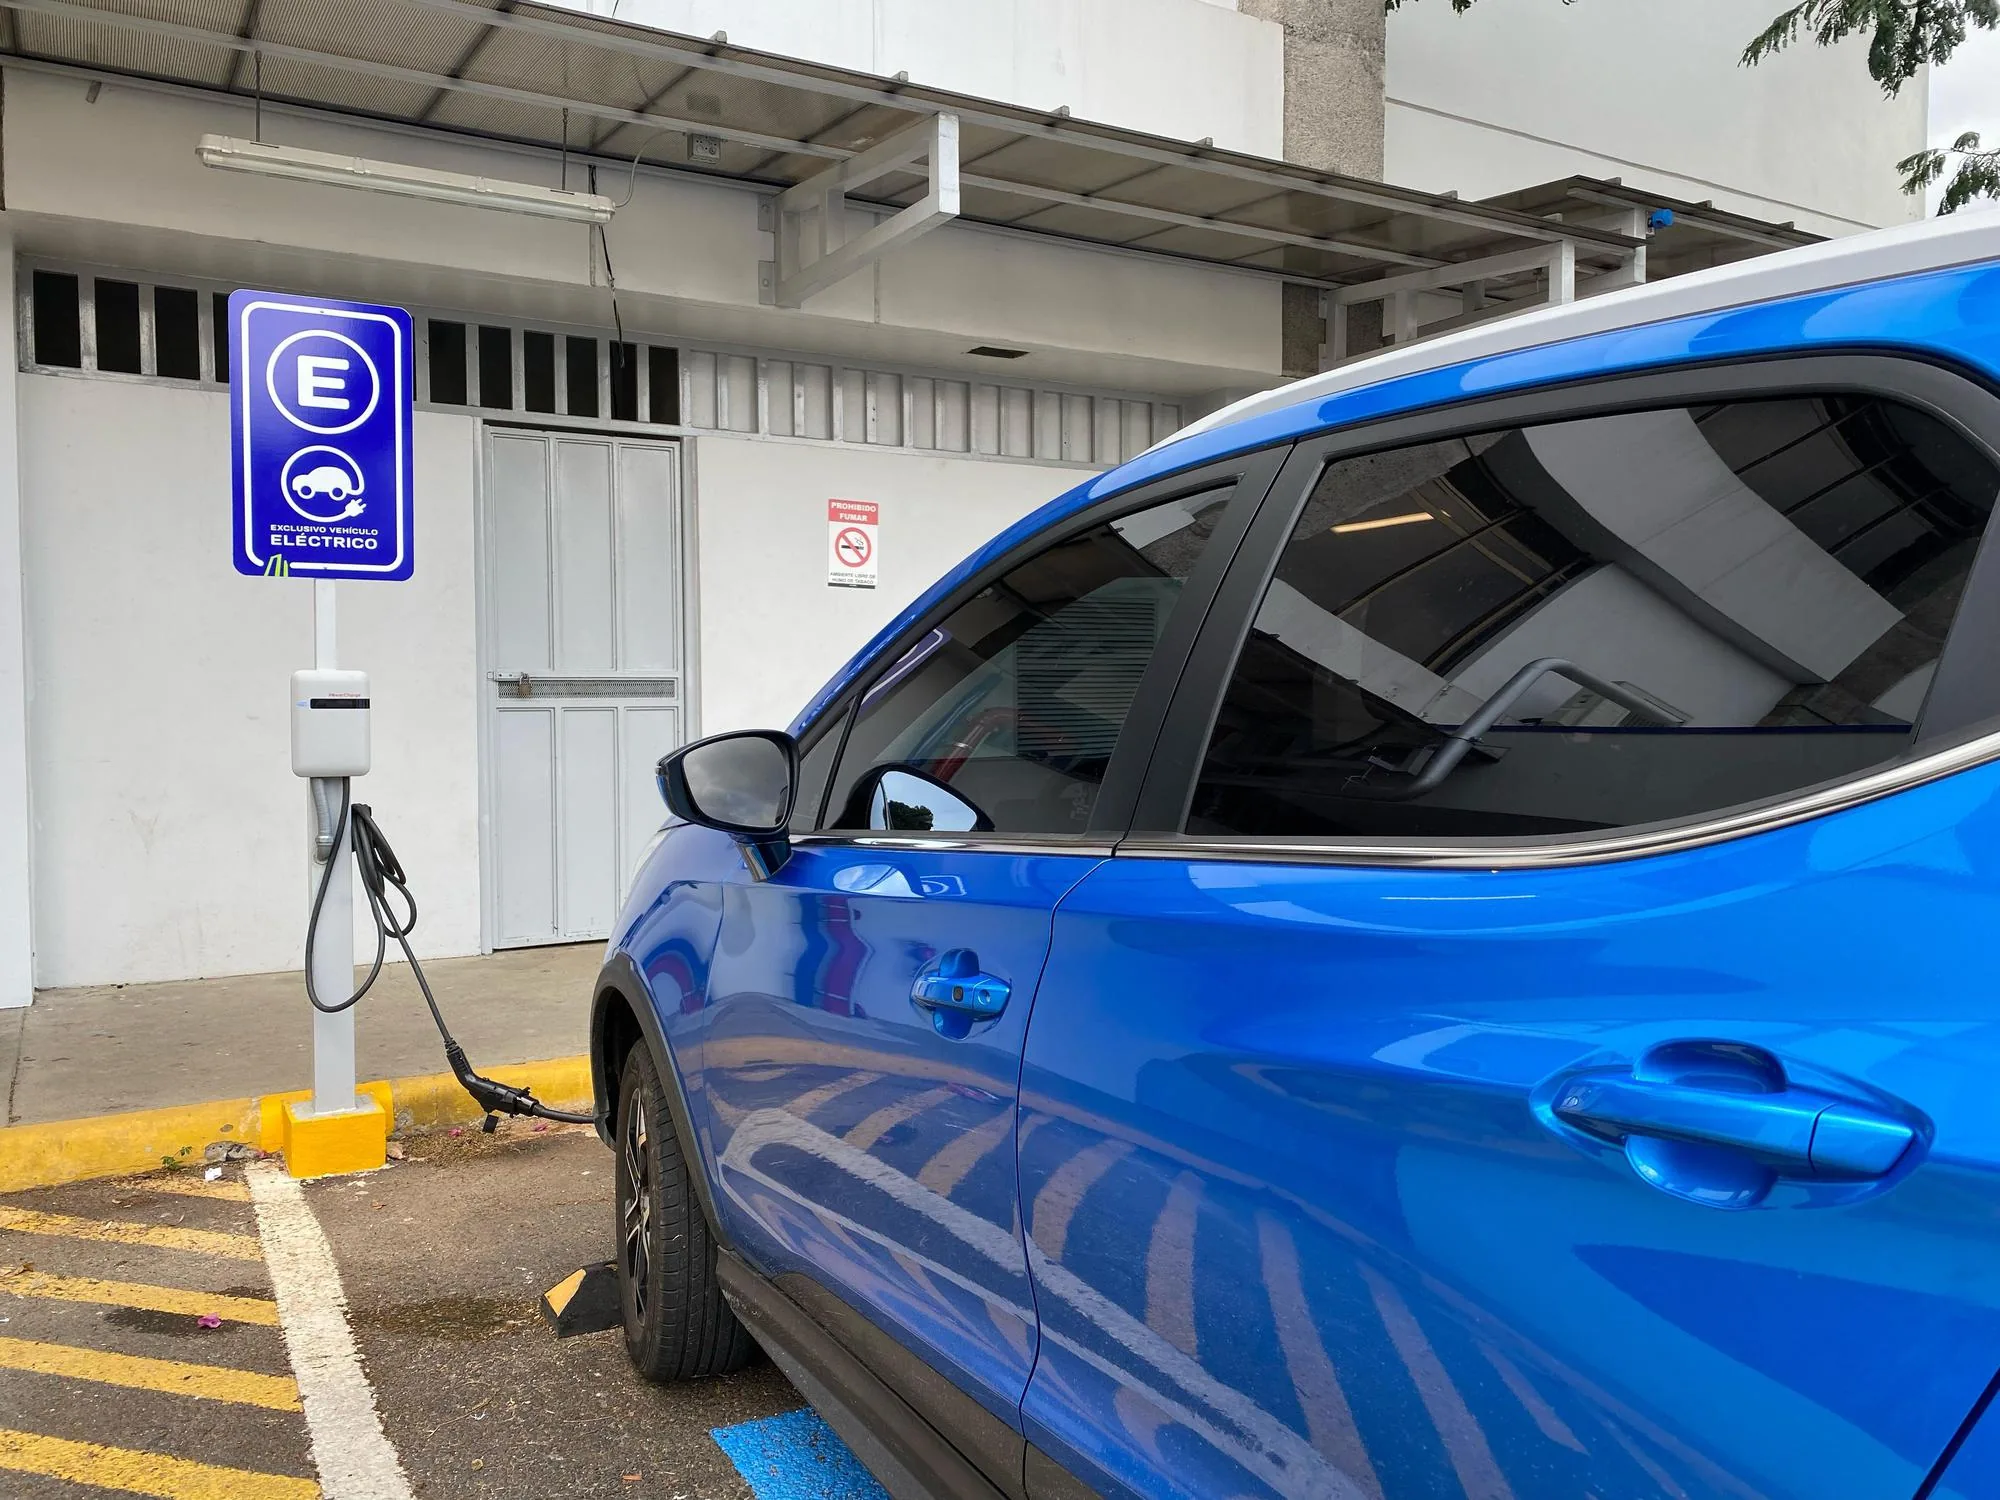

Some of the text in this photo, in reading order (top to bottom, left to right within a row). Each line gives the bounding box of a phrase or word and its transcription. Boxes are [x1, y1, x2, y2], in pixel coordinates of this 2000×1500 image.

[297, 355, 350, 410] E
[831, 502, 877, 512] PROHIBIDO
[839, 512, 868, 522] FUMAR
[270, 524, 379, 536] EXCLUSIVO VEHÍCULO
[270, 532, 378, 550] ELÉCTRICO
